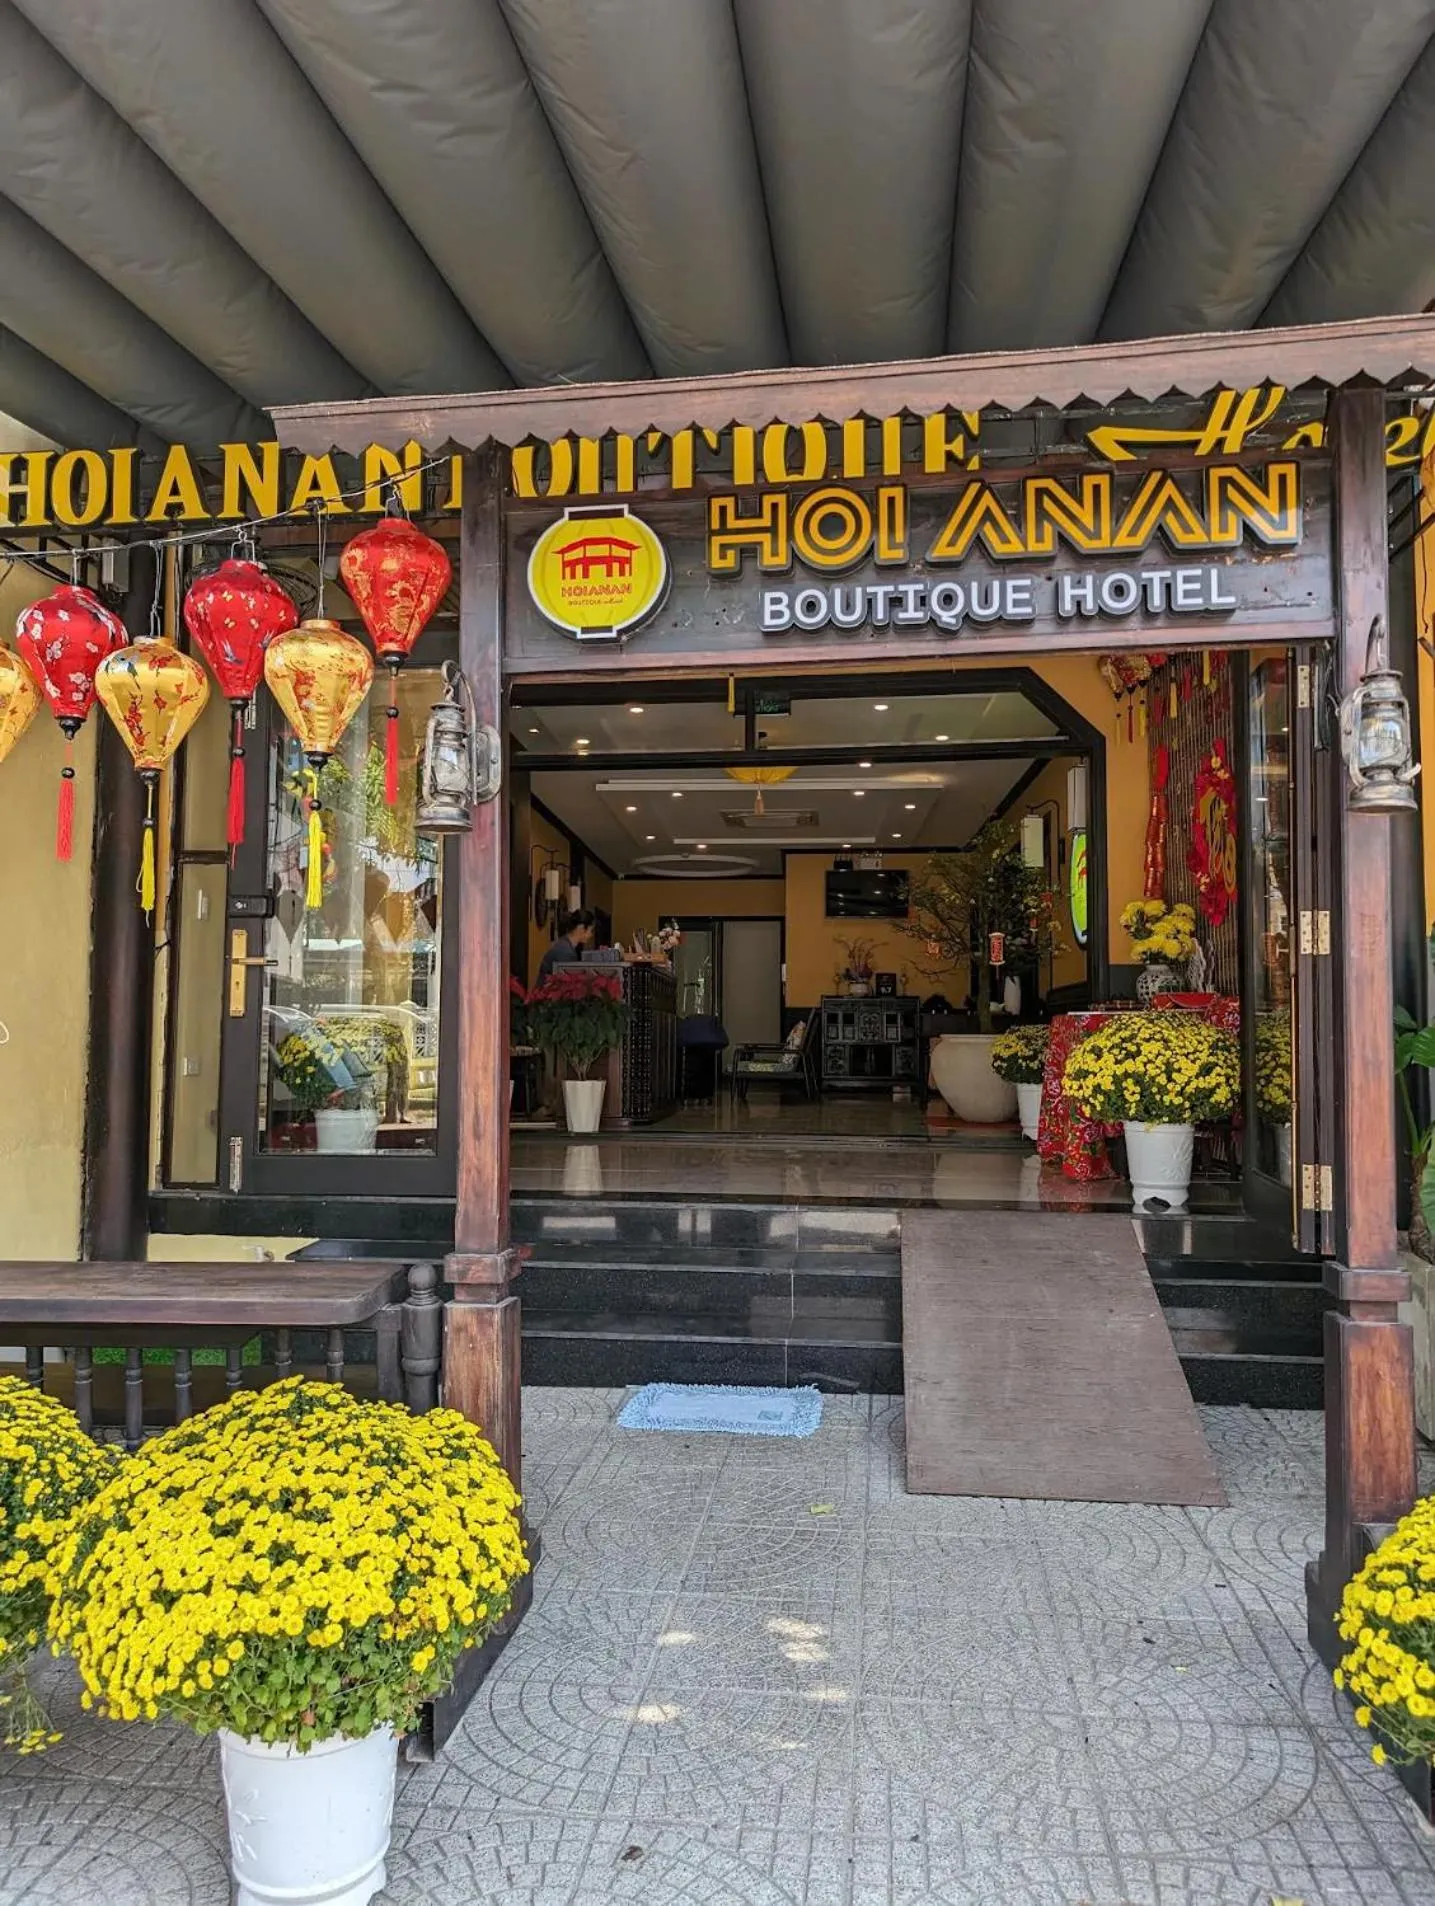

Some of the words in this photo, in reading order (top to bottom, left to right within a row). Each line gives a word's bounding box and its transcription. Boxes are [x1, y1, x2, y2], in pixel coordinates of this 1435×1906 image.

[711, 485, 906, 571] HOI
[932, 463, 1300, 562] ANAN
[763, 578, 1034, 629] BOUTIQUE
[1063, 567, 1236, 614] HOTEL
